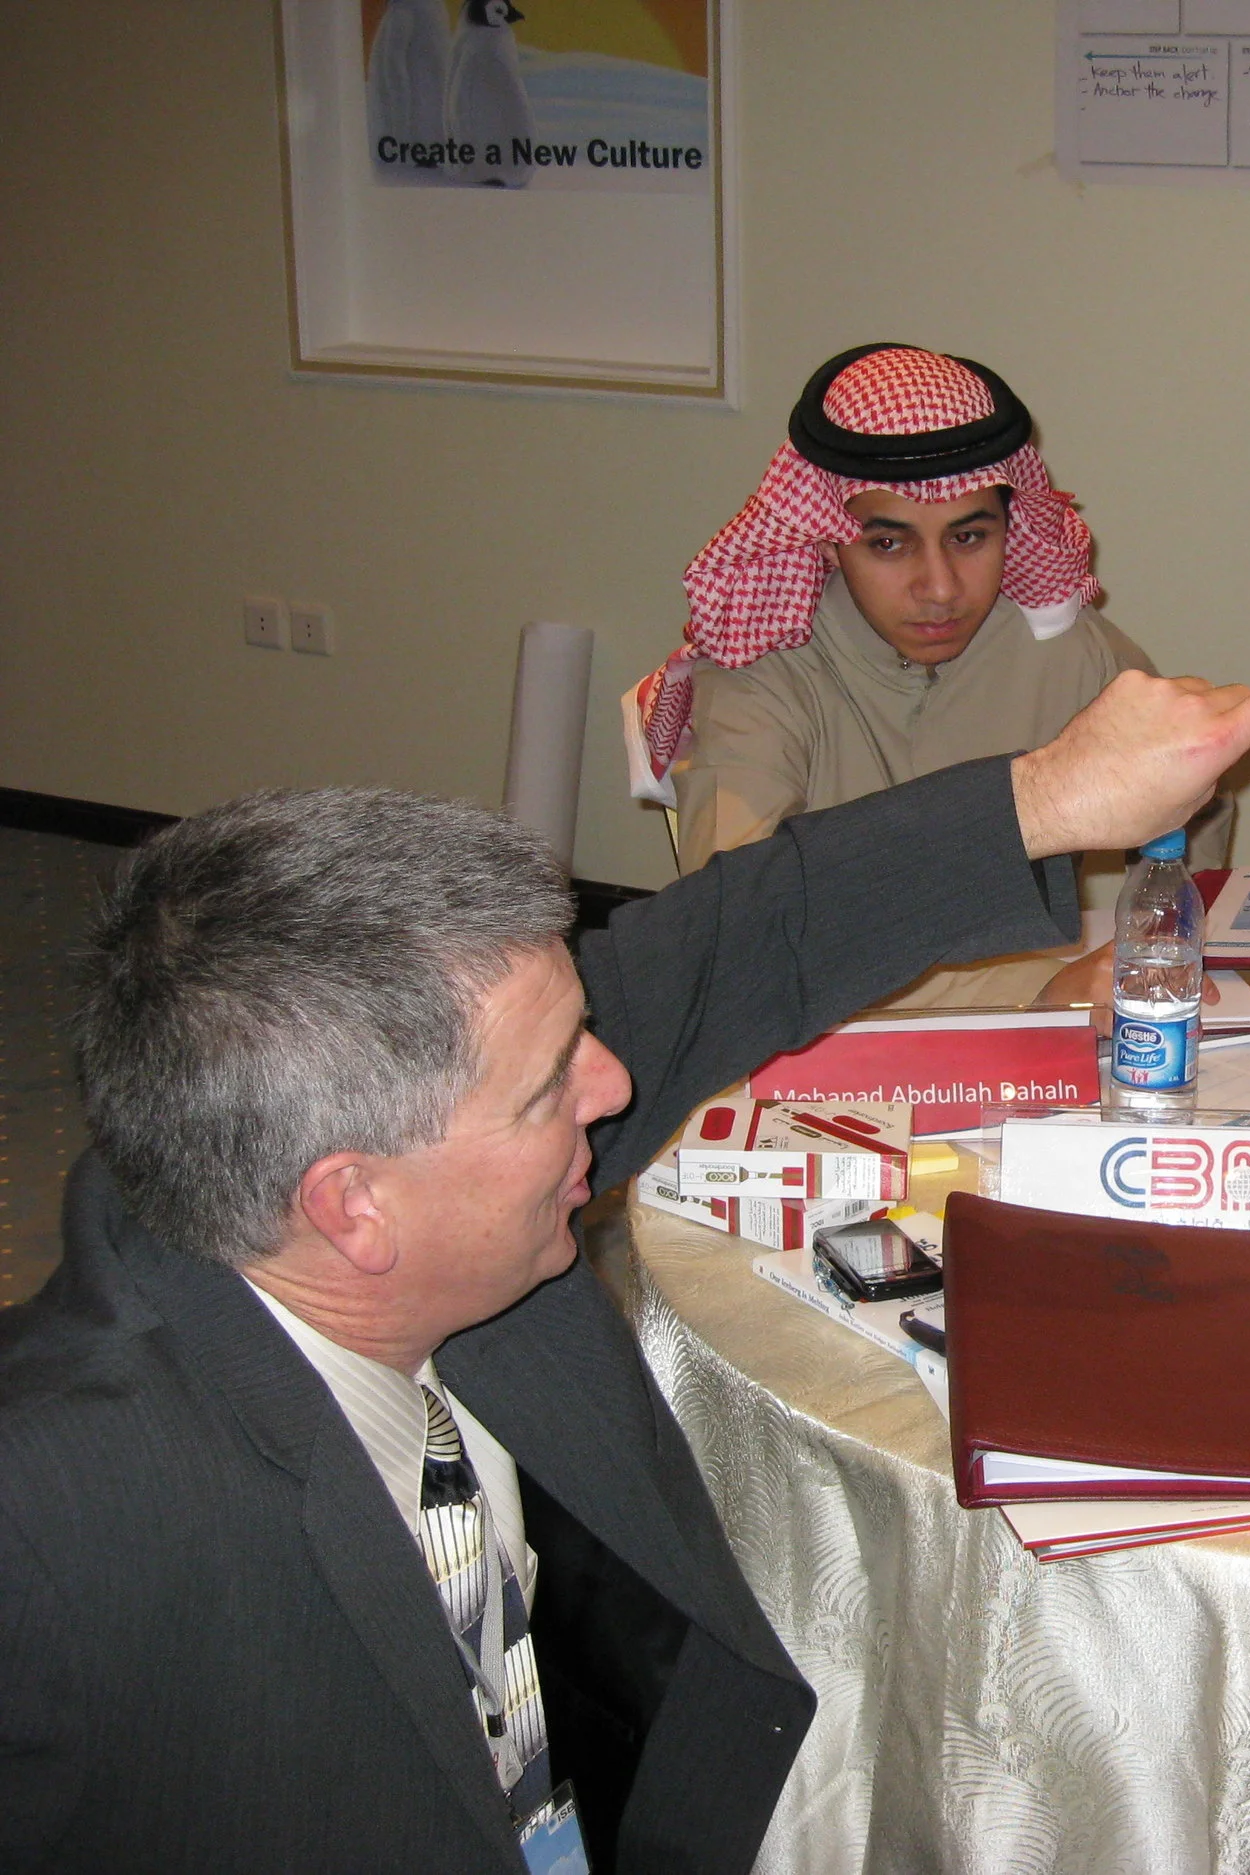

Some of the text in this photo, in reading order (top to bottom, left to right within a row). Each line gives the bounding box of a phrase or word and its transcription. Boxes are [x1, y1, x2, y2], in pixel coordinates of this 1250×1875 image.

[1091, 65, 1127, 84] Keep
[1133, 61, 1165, 80] them
[1093, 81, 1219, 106] Anchor the change
[377, 136, 702, 170] Create a New Culture
[1124, 1028, 1157, 1042] Nestlé
[1120, 1049, 1140, 1061] Pure
[1140, 1053, 1161, 1064] Life
[891, 1081, 992, 1104] Abdullah
[1000, 1079, 1078, 1101] Dahaln
[708, 1172, 735, 1182] ROCO
